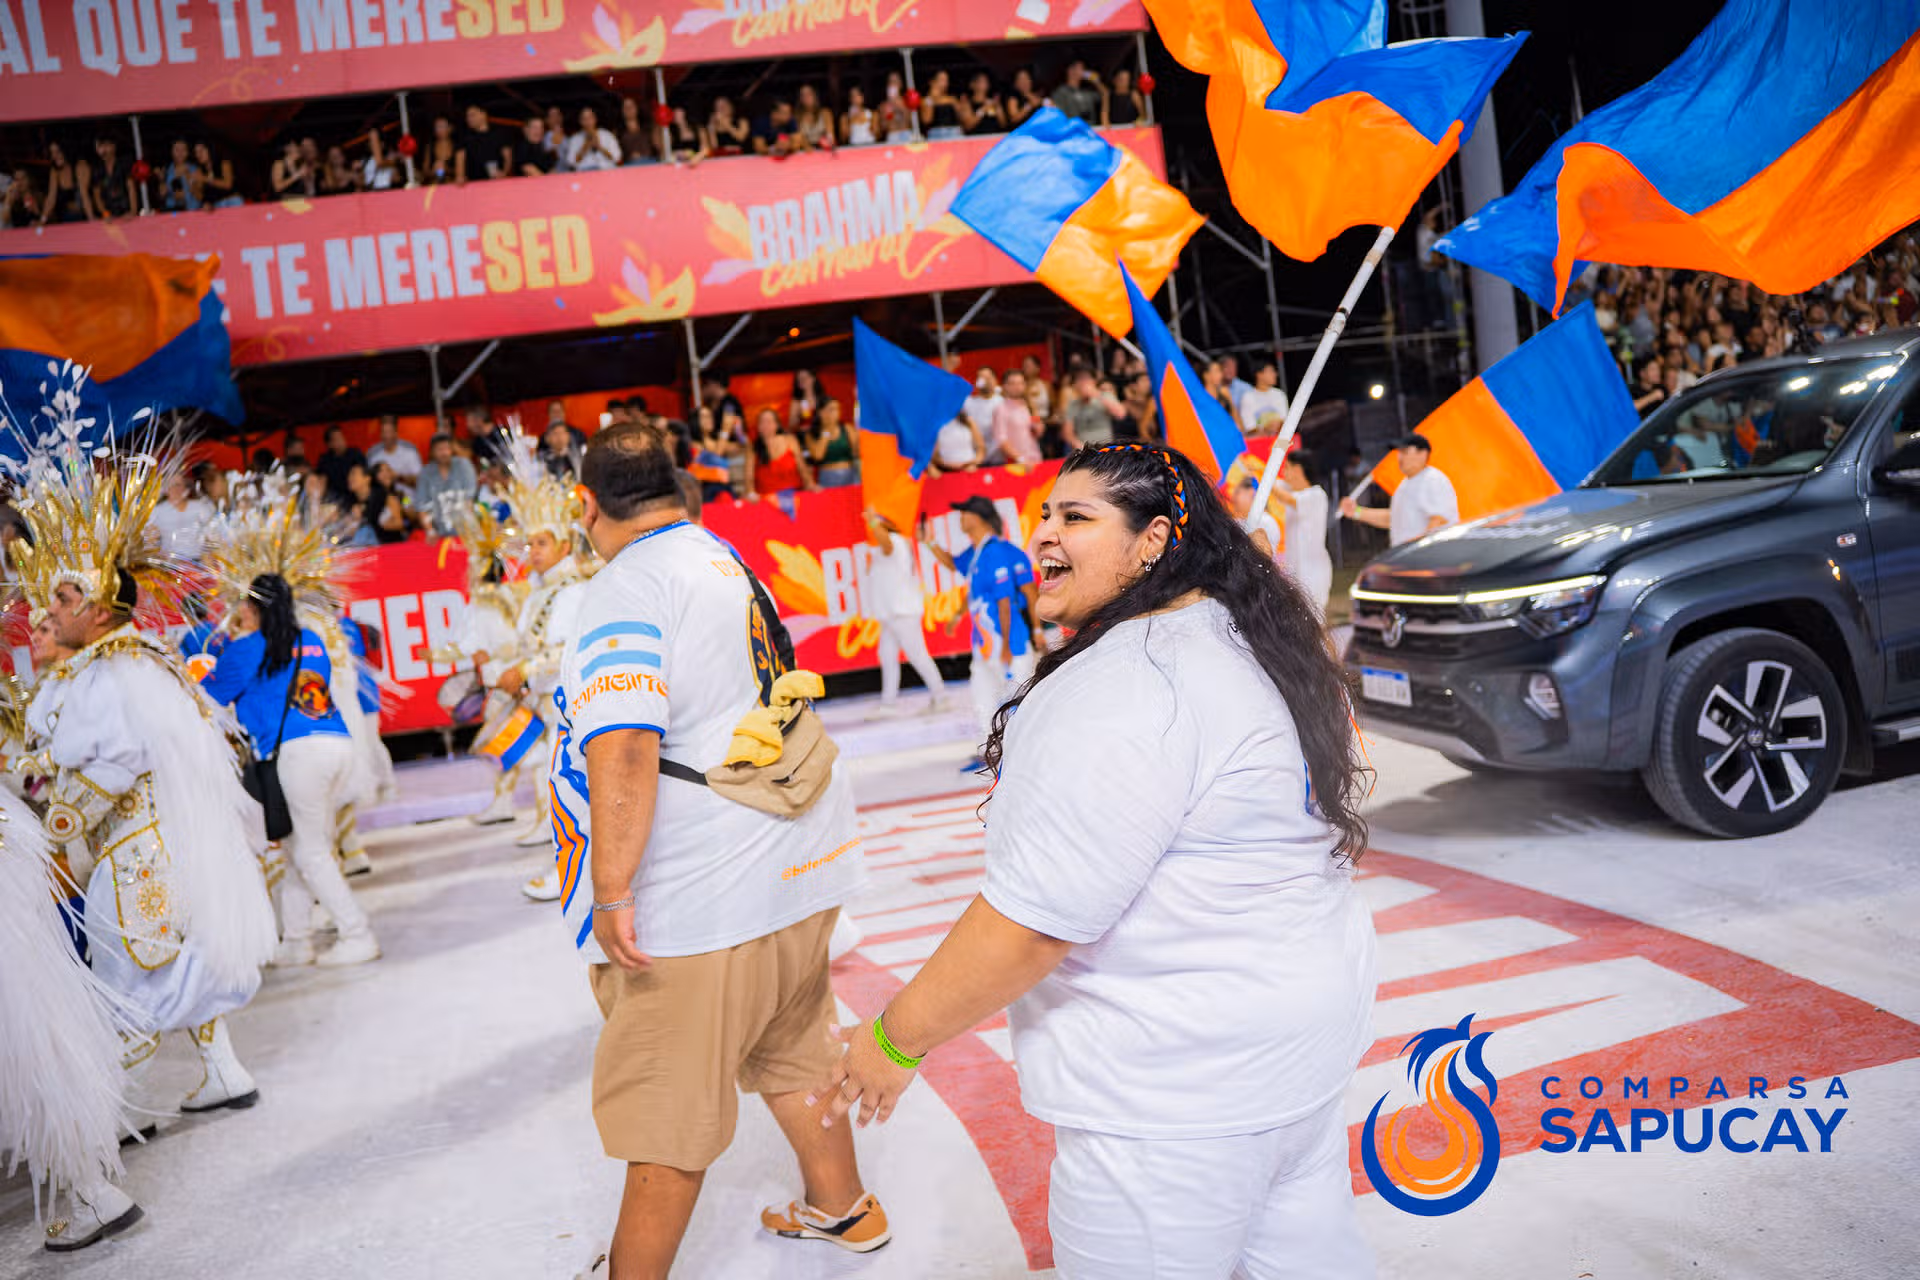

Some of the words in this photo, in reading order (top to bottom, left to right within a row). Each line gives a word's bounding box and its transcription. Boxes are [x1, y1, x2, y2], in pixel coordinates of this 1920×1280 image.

[72, 0, 197, 77] QUE
[208, 0, 281, 60] TE
[241, 242, 313, 319] TE
[324, 214, 594, 312] MERESED
[748, 169, 924, 270] BRAHMA
